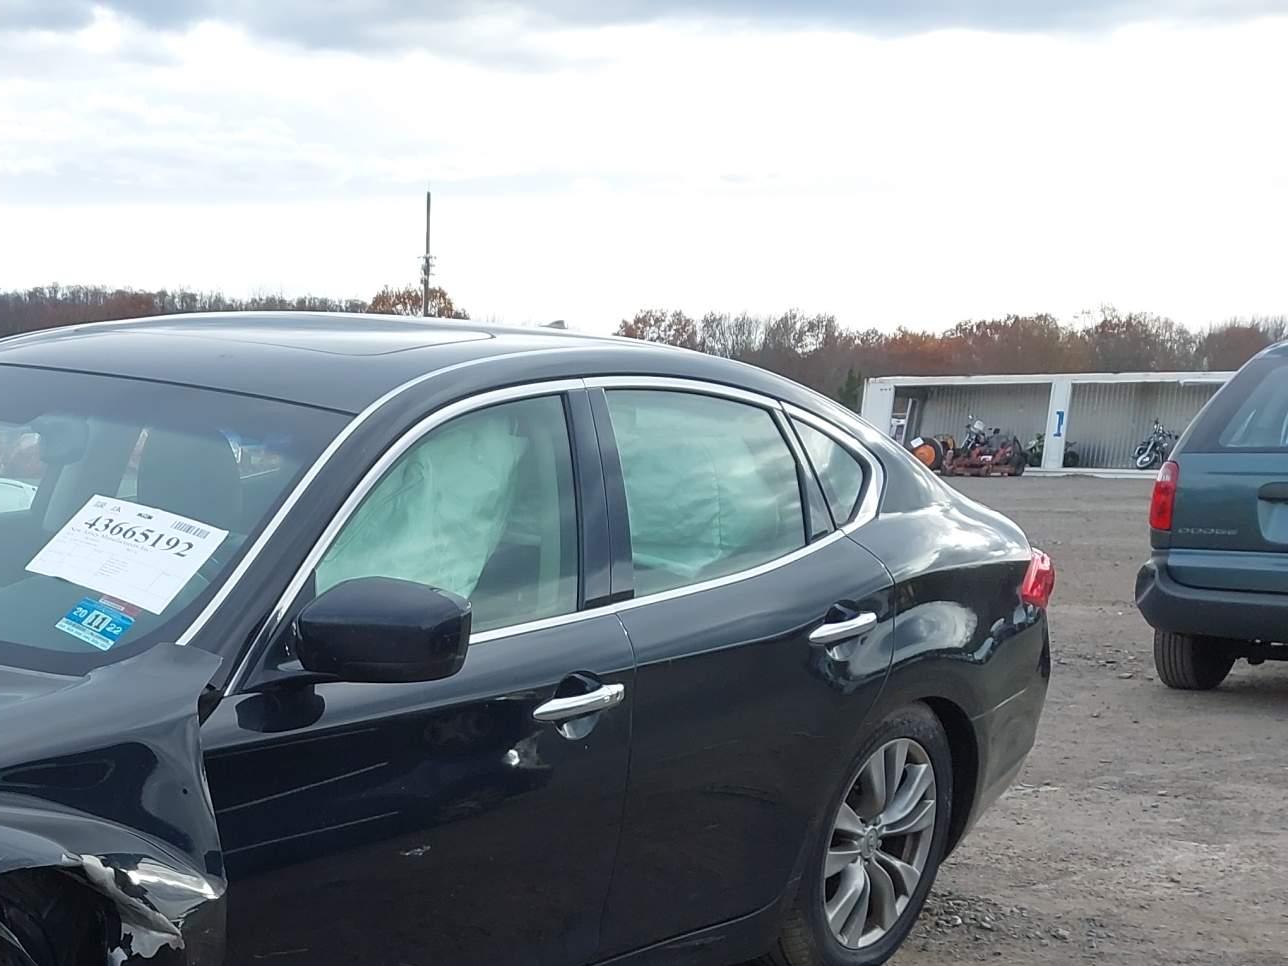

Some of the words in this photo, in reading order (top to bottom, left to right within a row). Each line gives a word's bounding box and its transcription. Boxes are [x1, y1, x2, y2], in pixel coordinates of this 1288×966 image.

[83, 514, 195, 558] 43665192
[73, 606, 88, 618] 20
[87, 613, 106, 630] 11
[106, 622, 123, 635] 22
